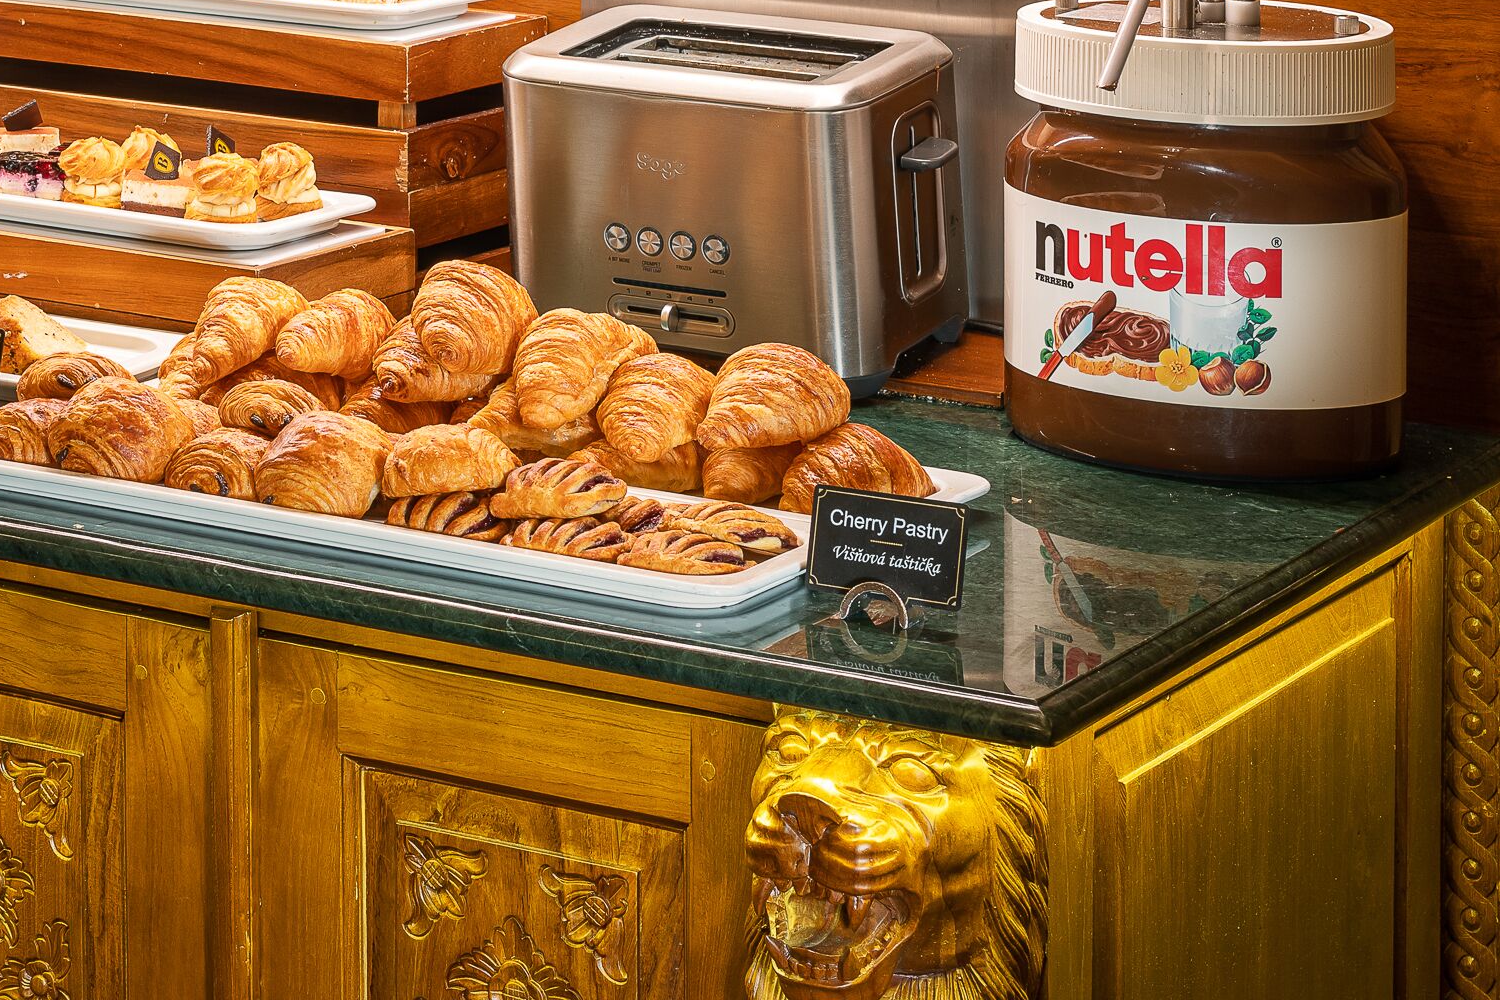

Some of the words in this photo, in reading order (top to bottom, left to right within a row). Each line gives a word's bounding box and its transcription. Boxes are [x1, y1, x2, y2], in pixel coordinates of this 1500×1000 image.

[1035, 220, 1282, 299] nutella
[1035, 272, 1074, 289] FERRERO
[830, 508, 888, 536] Cherry
[893, 517, 949, 545] Pastry
[832, 545, 886, 566] Višňová
[889, 555, 942, 577] taštička
